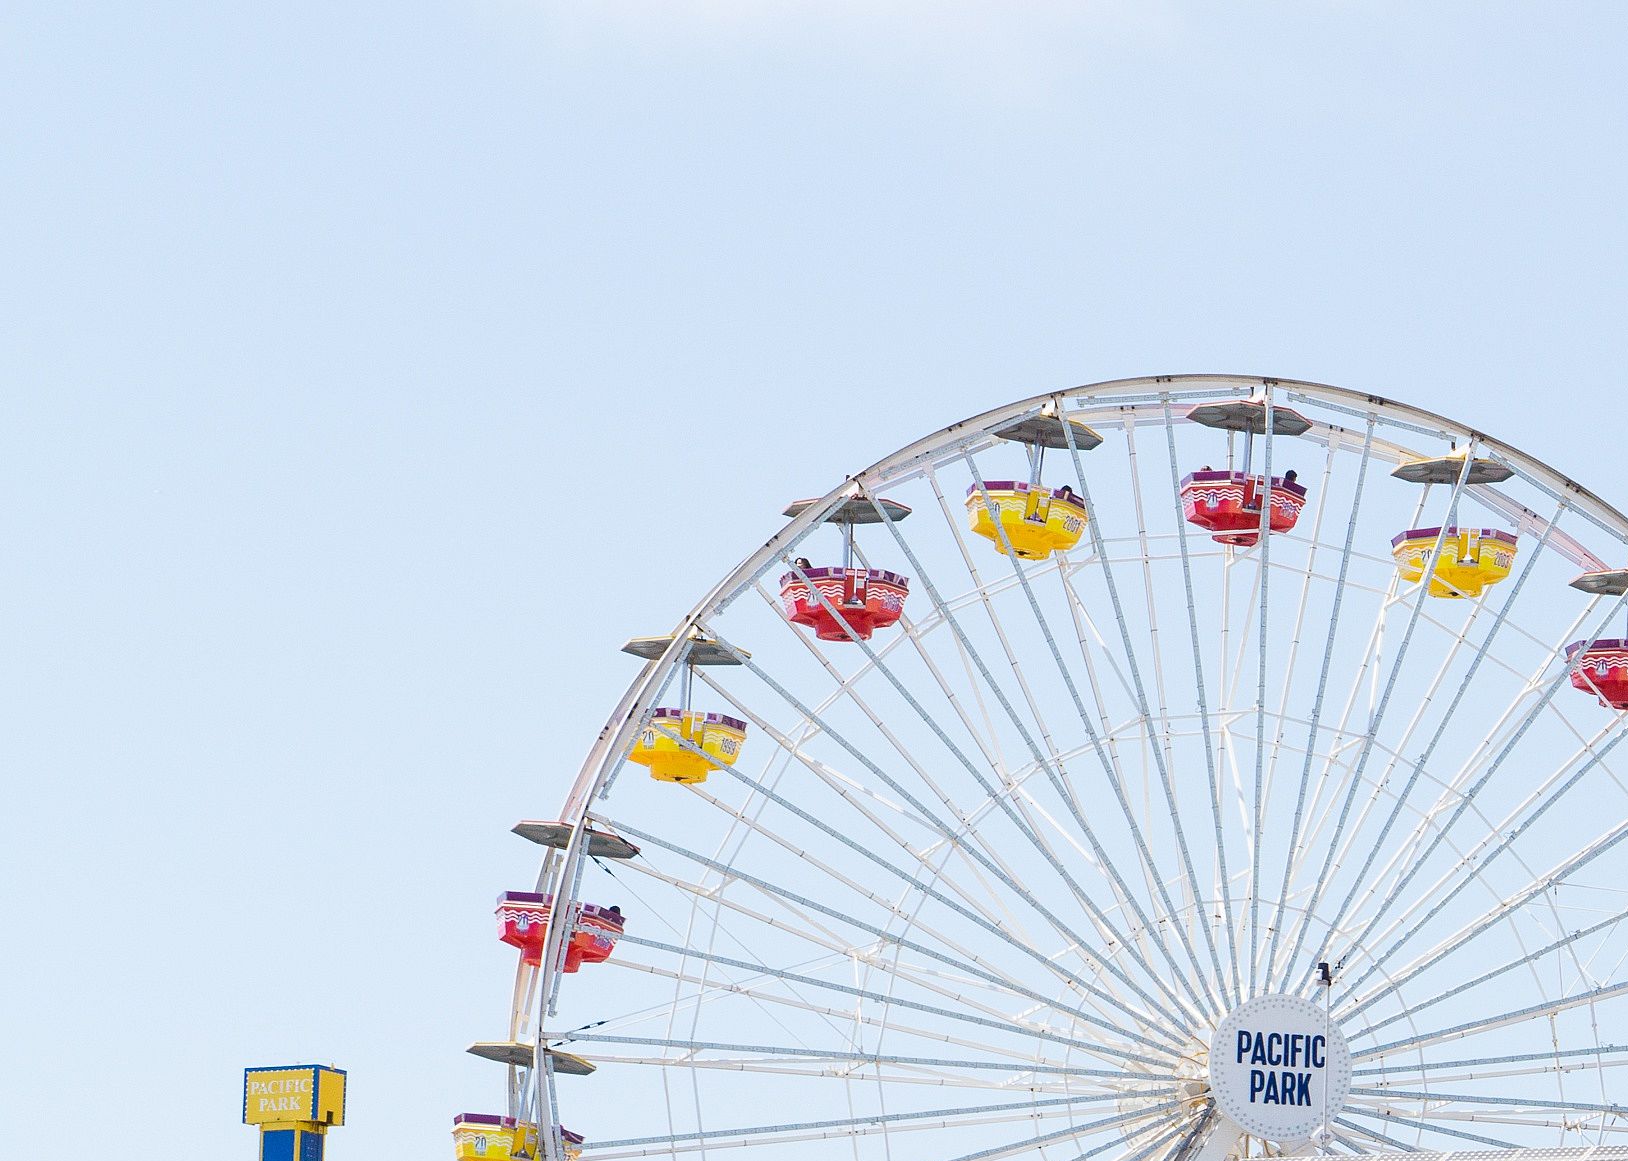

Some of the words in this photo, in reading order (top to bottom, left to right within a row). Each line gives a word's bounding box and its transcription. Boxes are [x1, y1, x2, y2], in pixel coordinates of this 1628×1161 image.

[1237, 1030, 1326, 1068] PACIFIC
[250, 1079, 311, 1095] PACIFIC
[1250, 1070, 1312, 1106] PARK
[259, 1096, 301, 1112] PARK
